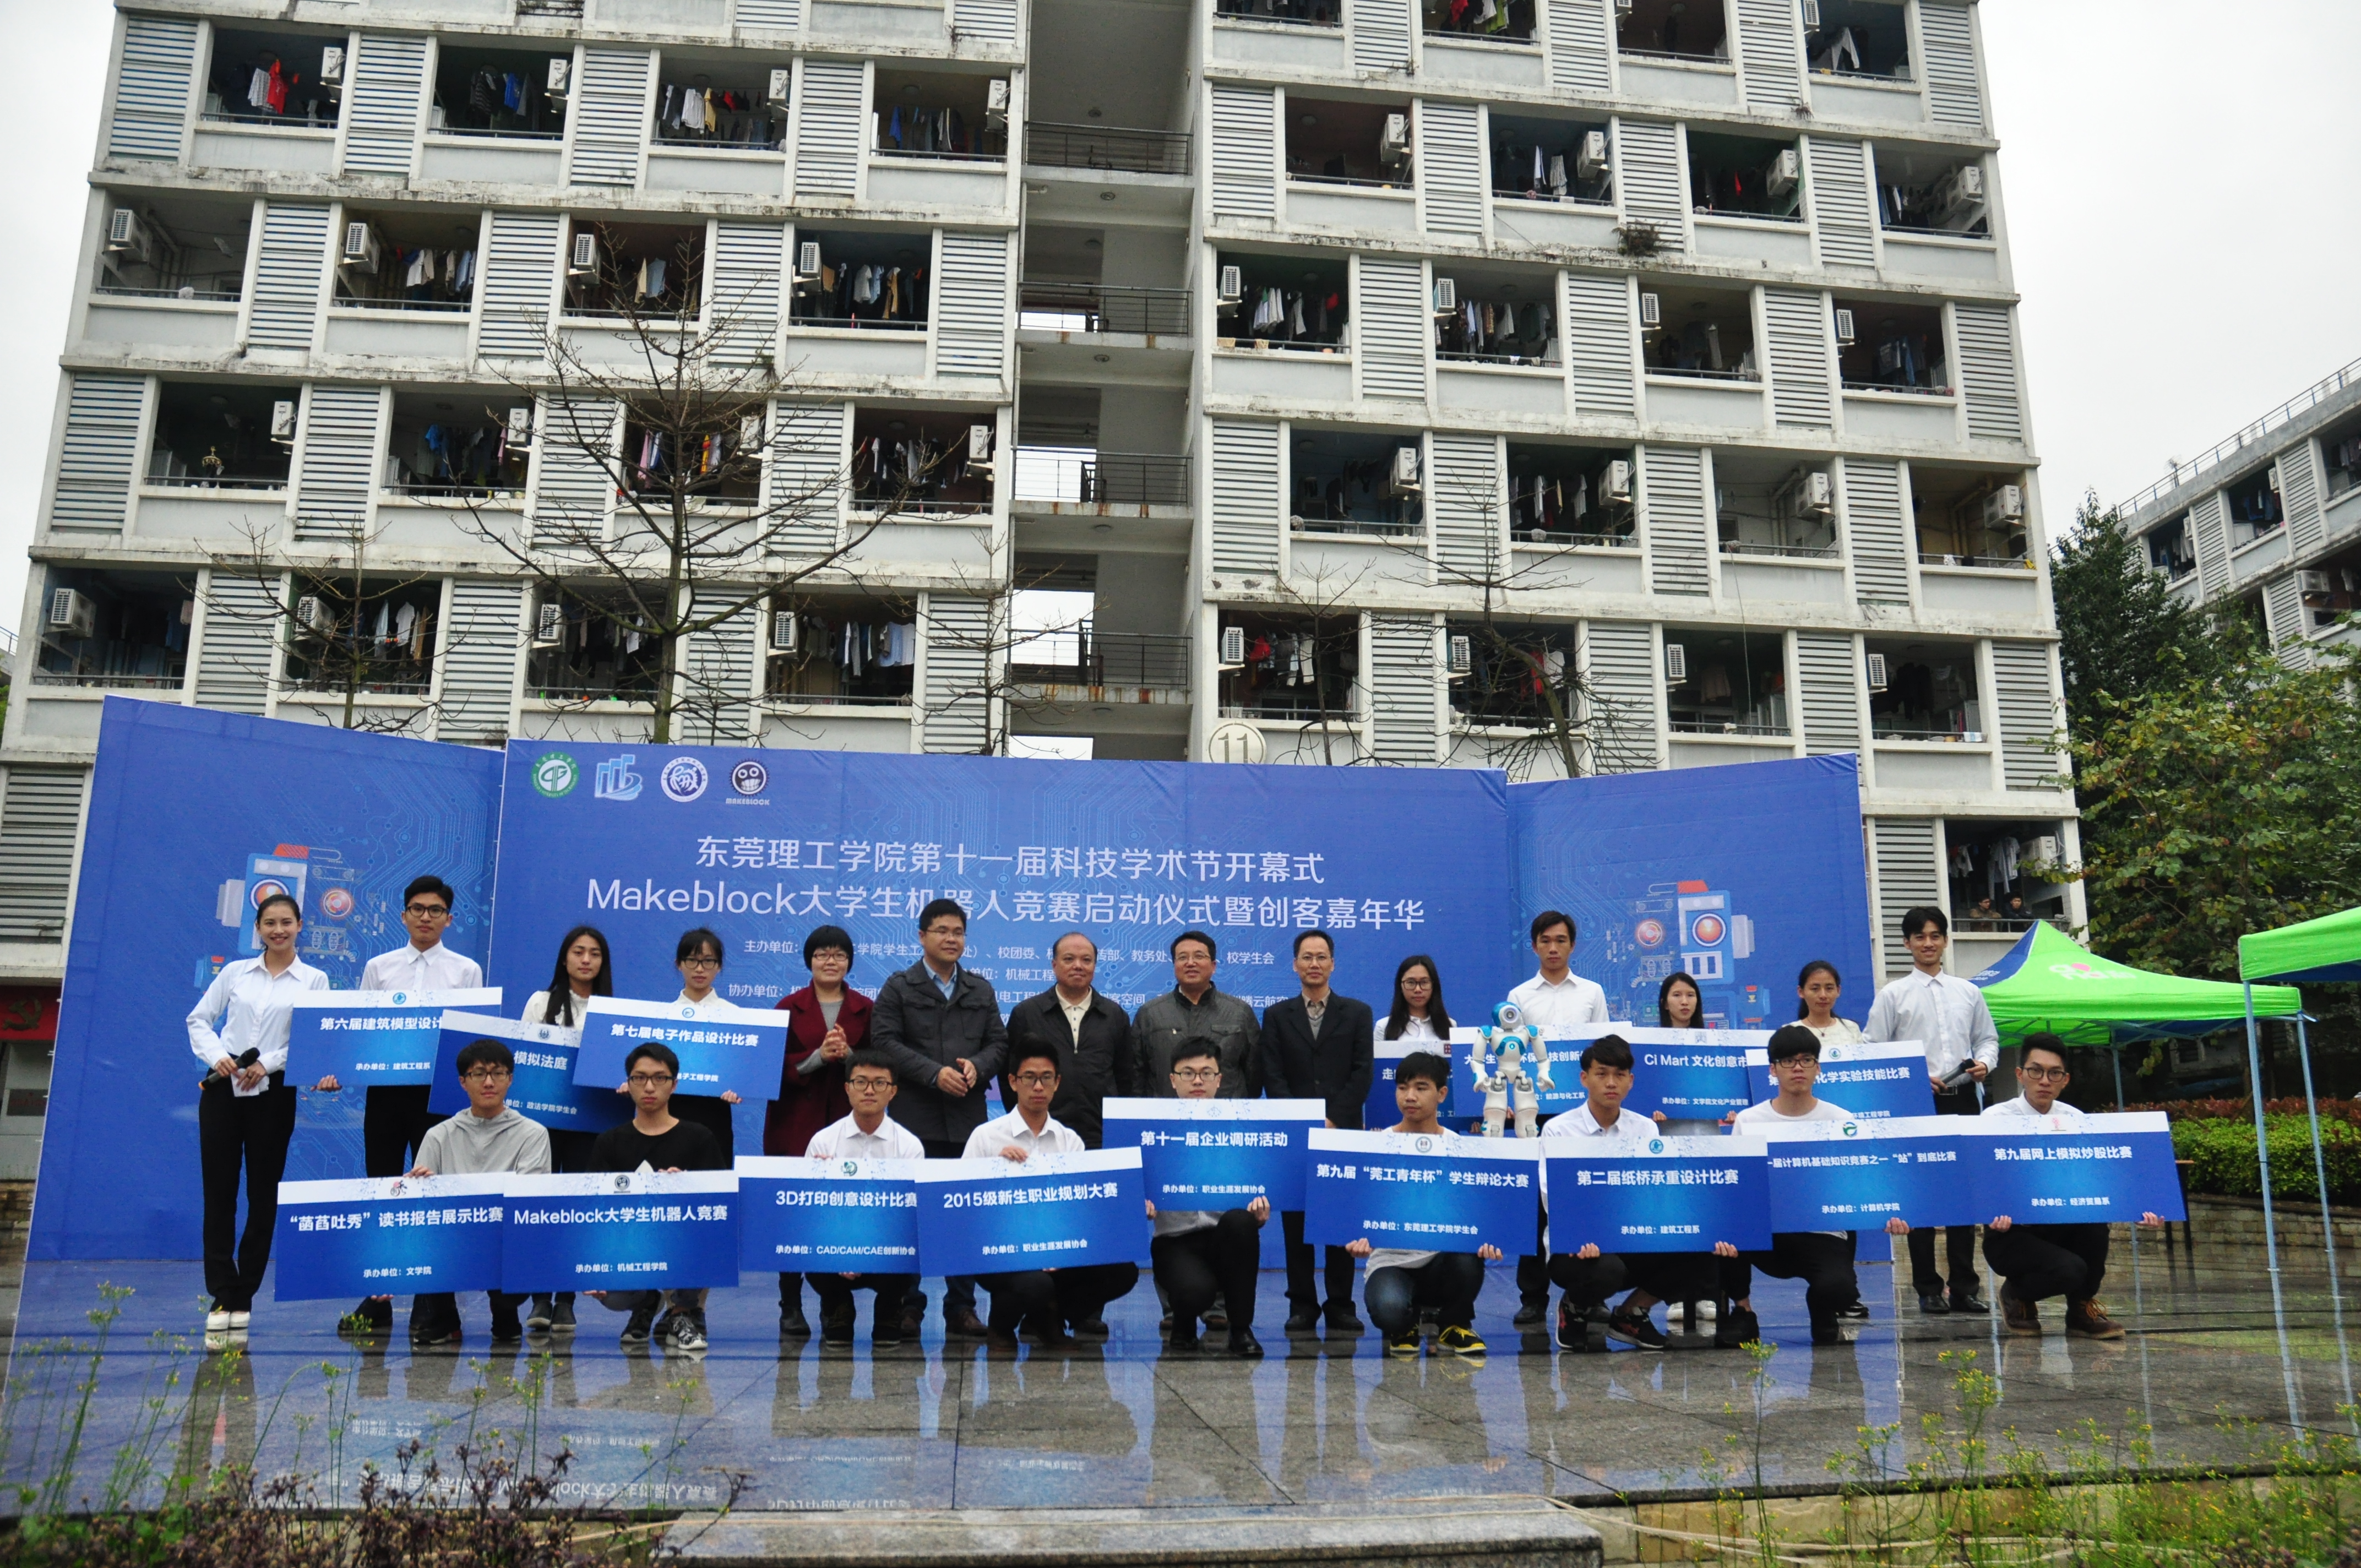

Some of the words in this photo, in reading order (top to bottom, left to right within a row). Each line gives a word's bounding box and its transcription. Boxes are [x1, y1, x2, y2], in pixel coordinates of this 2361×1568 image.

[1218, 733, 1248, 764] 11
[696, 836, 1325, 884] 东莞理工学院第十一届科技学术节开幕式
[611, 1023, 759, 1047] 第七届电子作品设计比赛
[513, 1050, 568, 1070] 模拟法庭
[1644, 1054, 1658, 1066] Ci
[1661, 1054, 1689, 1067] Mart
[503, 1098, 578, 1115] 单位：政法学院学生会
[1141, 1131, 1288, 1147] 第十一届企业调研活动
[1994, 1146, 2133, 1161] 第九届网上模拟炒股比赛
[1577, 1169, 1739, 1186] 第二届纸桥承重设计比赛
[776, 1190, 917, 1207] 3D打印创意设计比赛
[943, 1182, 1118, 1208] 2015级新生职业规划大赛
[514, 1205, 727, 1224] Makeblock大学生机器人竞赛
